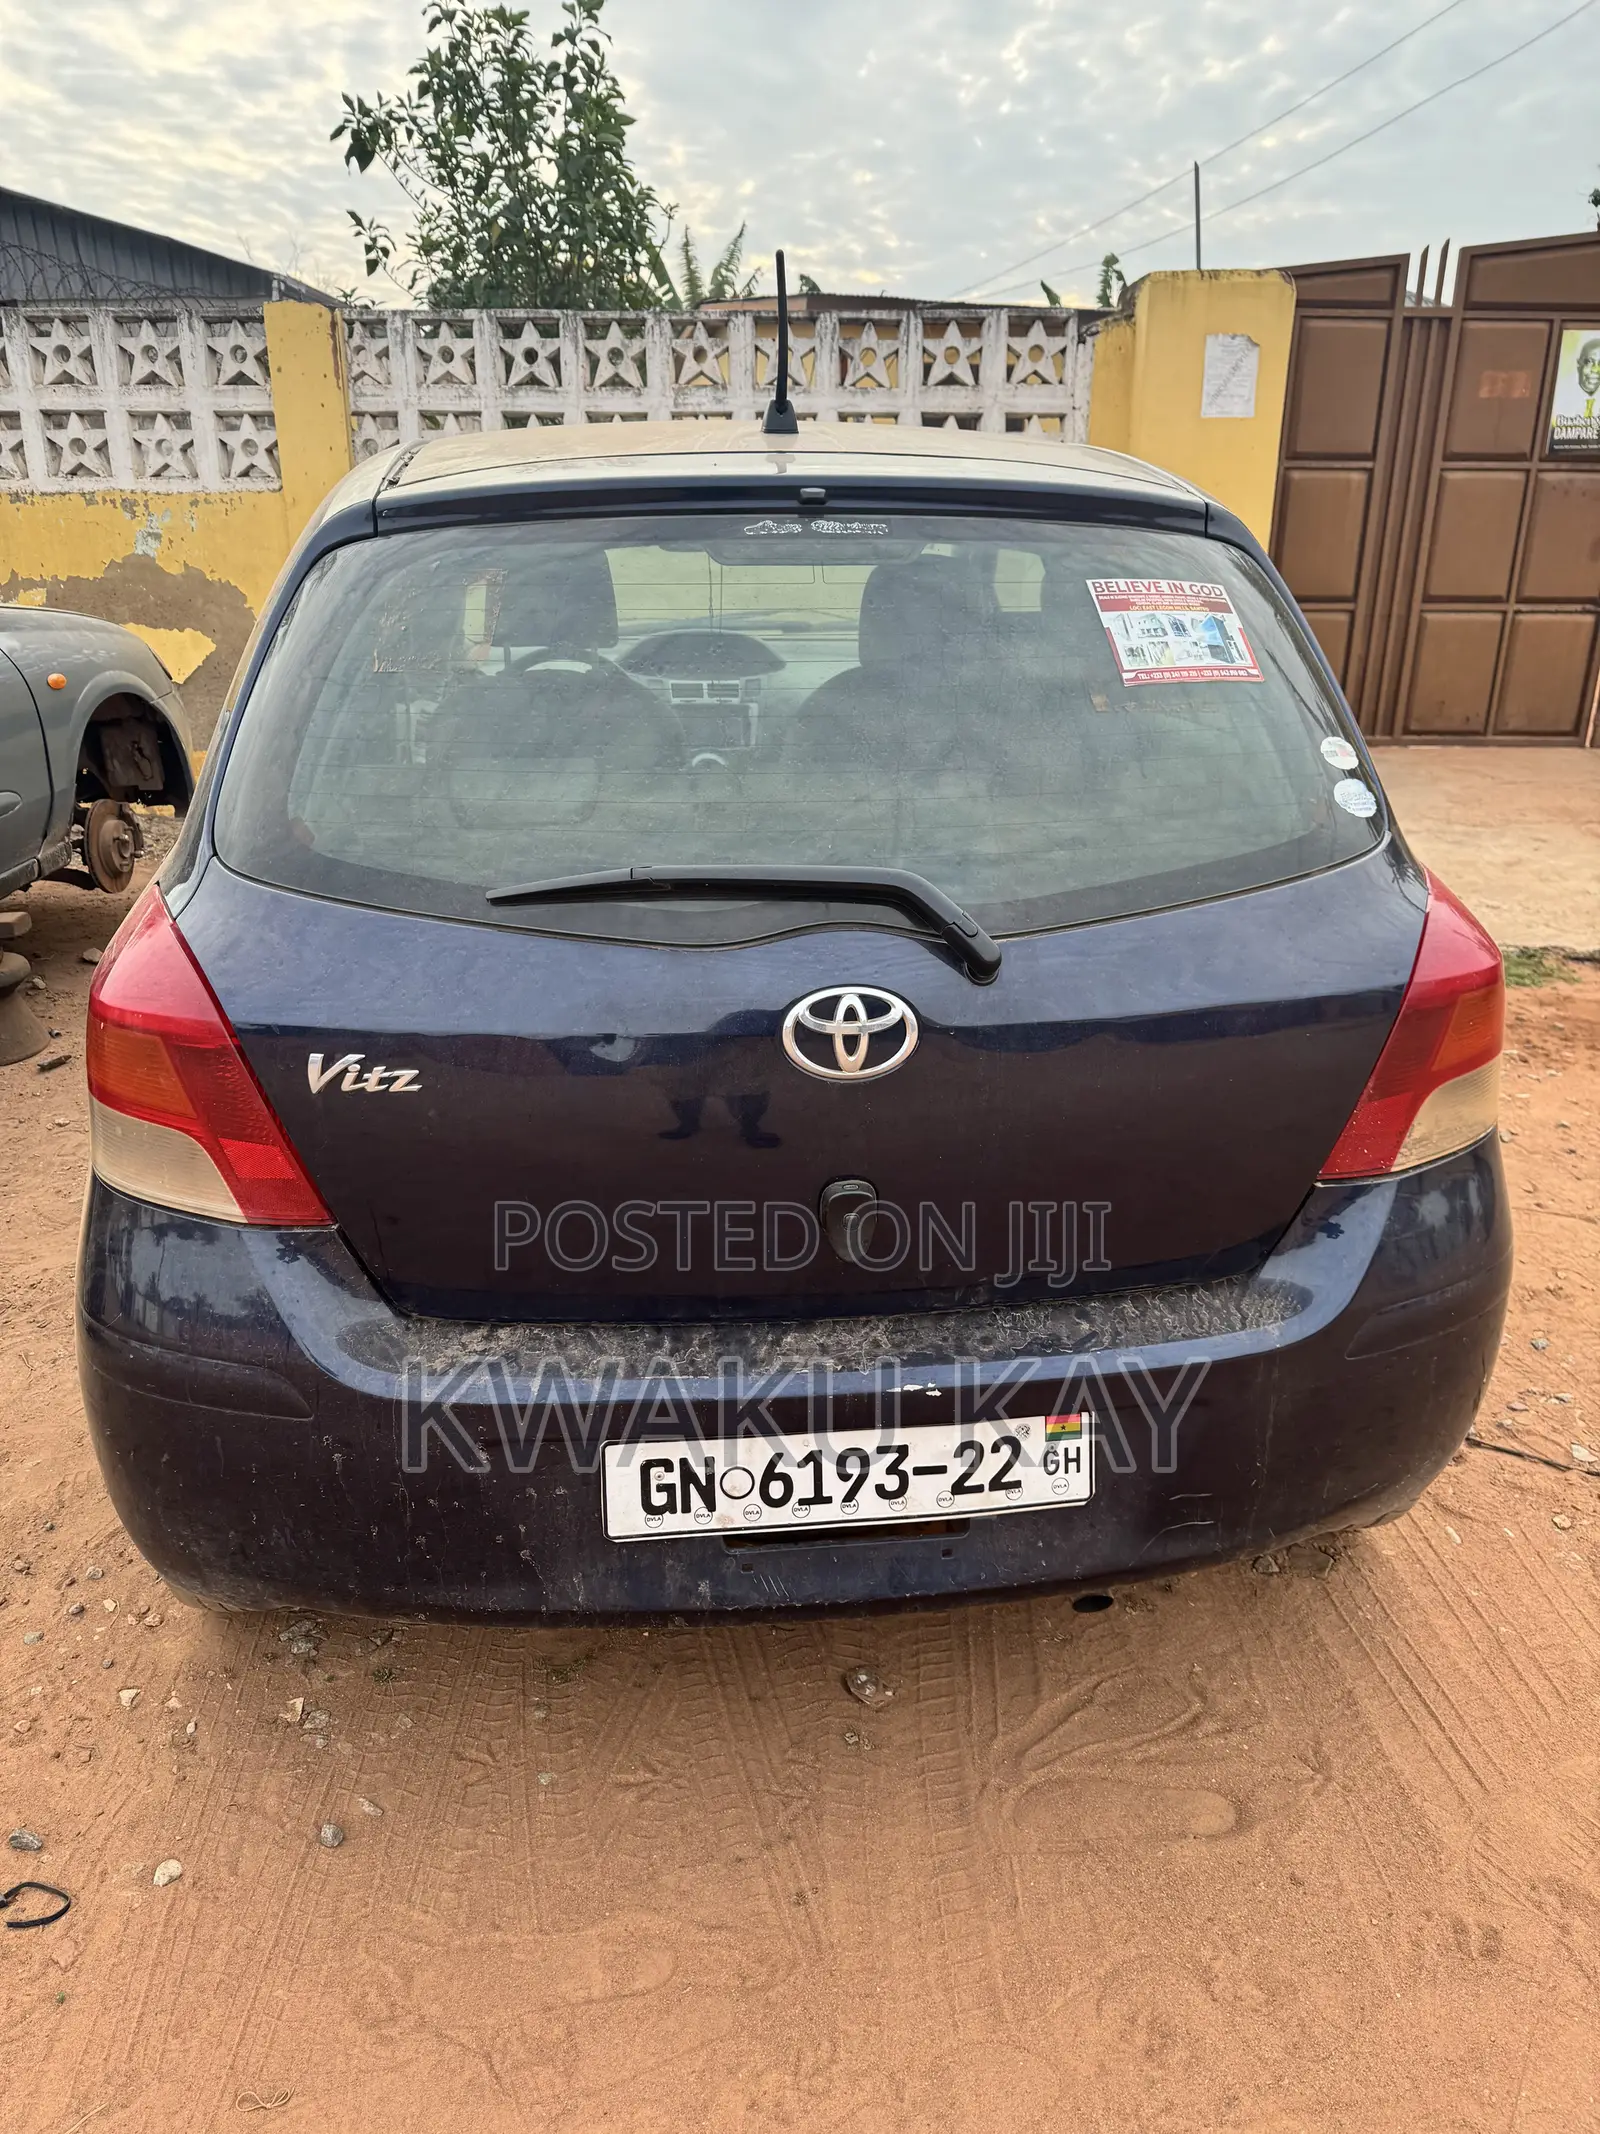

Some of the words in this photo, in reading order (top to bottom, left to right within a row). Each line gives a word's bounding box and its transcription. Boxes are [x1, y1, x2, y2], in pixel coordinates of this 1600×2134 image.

[1091, 580, 1165, 594] BELIEVE
[1166, 581, 1186, 594] IN
[1188, 583, 1224, 597] GOD
[308, 1053, 423, 1094] Vitz
[640, 1456, 717, 1515] GN
[759, 1435, 1022, 1508] 6193-22
[1043, 1446, 1081, 1476] GH
